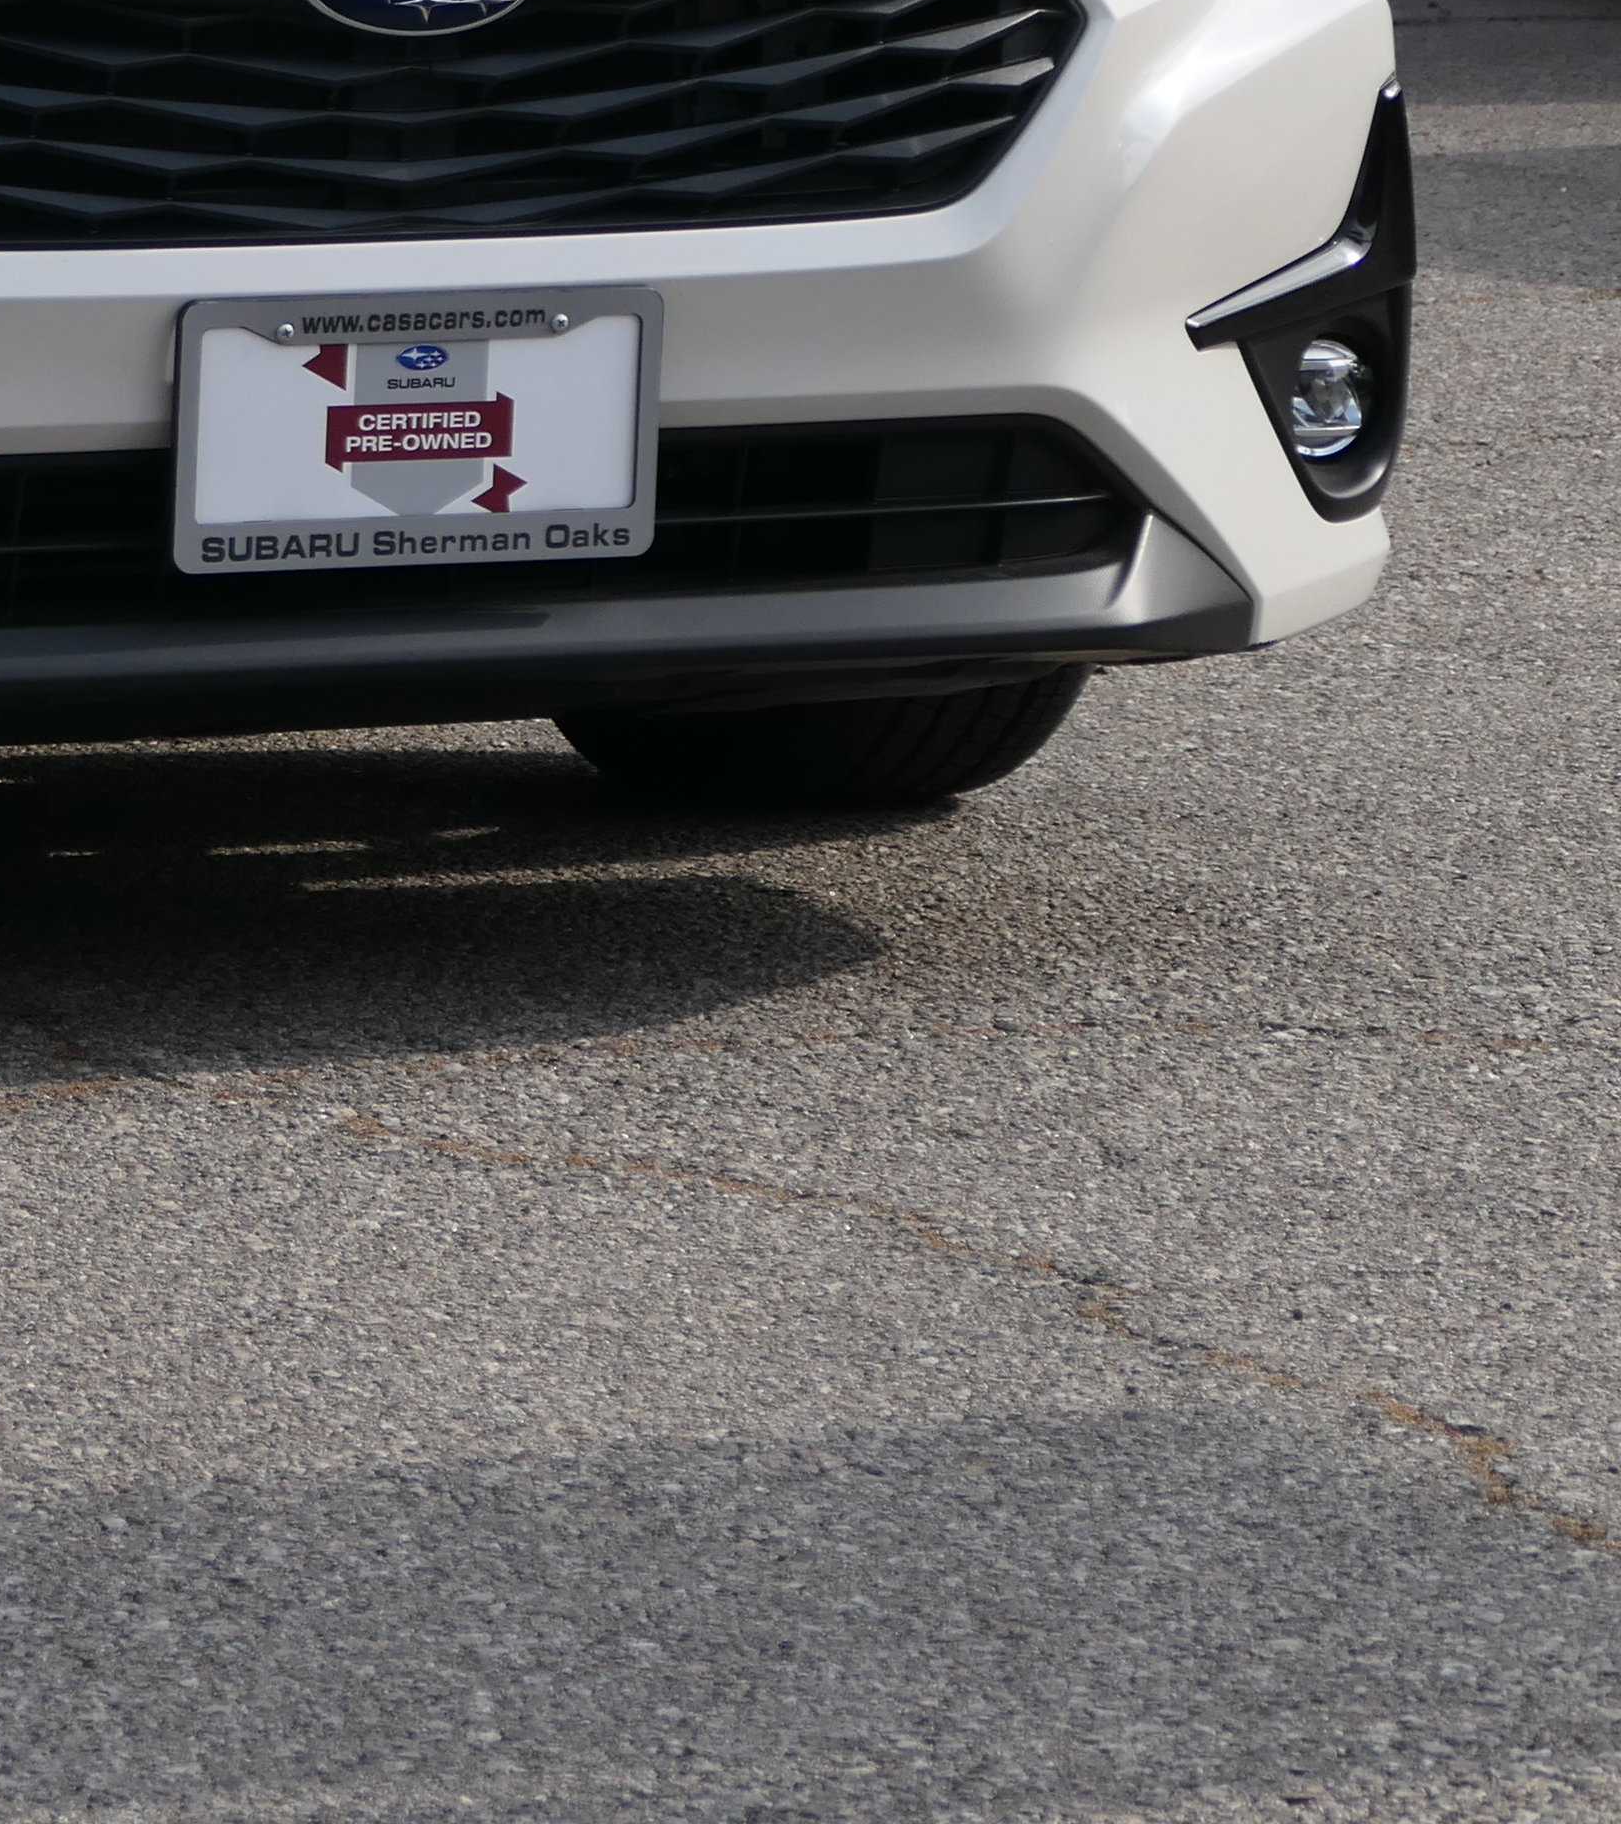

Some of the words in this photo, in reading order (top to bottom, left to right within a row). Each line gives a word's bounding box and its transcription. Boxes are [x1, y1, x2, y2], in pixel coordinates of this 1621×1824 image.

[302, 307, 547, 335] www.casacars.com
[387, 376, 456, 389] SUBARU
[358, 411, 482, 433] CERTIFIED
[345, 431, 493, 454] PRE-OWNED
[201, 531, 361, 564] SUBARU
[372, 529, 533, 558] Sherman
[544, 522, 632, 549] Oaks
